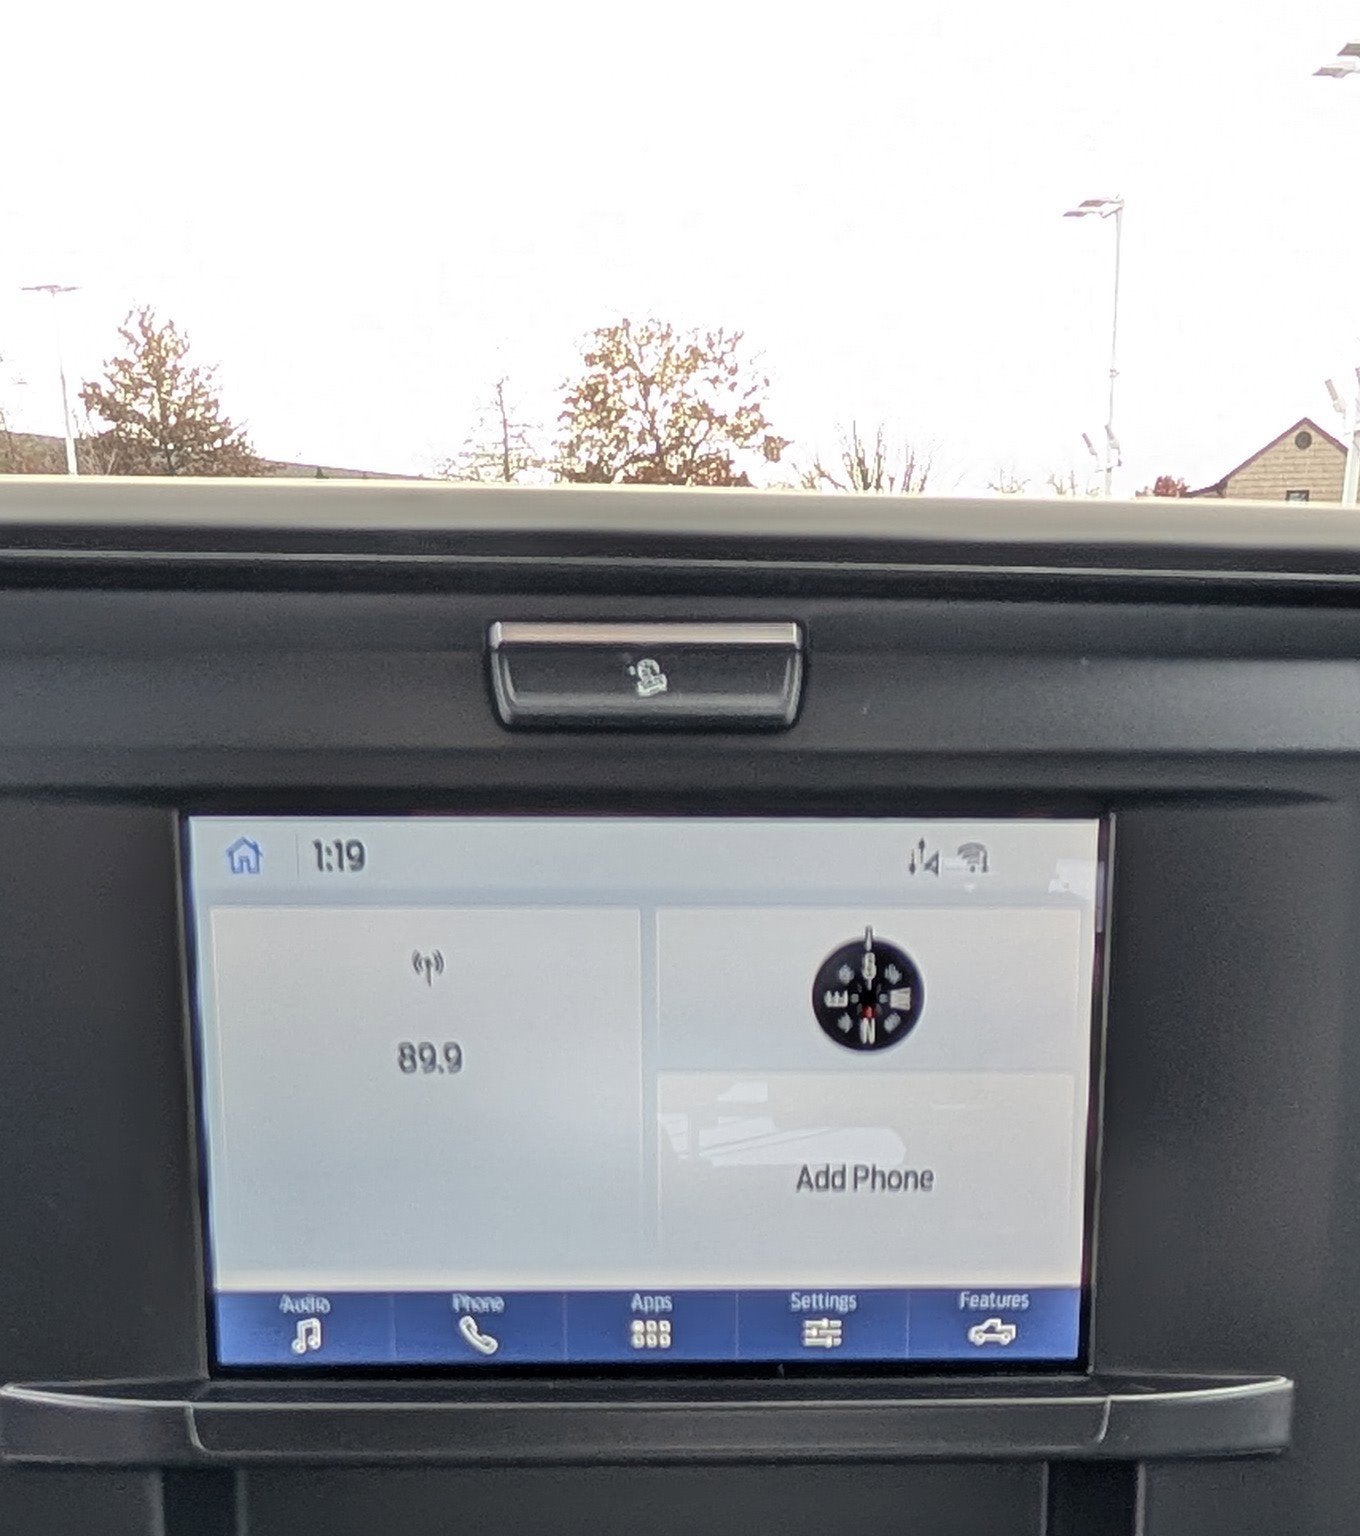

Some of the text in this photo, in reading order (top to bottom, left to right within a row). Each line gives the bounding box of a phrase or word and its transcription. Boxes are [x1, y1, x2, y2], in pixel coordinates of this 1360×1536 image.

[312, 840, 367, 874] 1:19
[397, 1042, 463, 1076] 89.9
[796, 1163, 934, 1193] Add Phone
[280, 1293, 331, 1314] Audio
[452, 1292, 505, 1314] Phone
[630, 1291, 674, 1317] Apps
[790, 1291, 857, 1318] Settings
[959, 1290, 1030, 1313] Features
